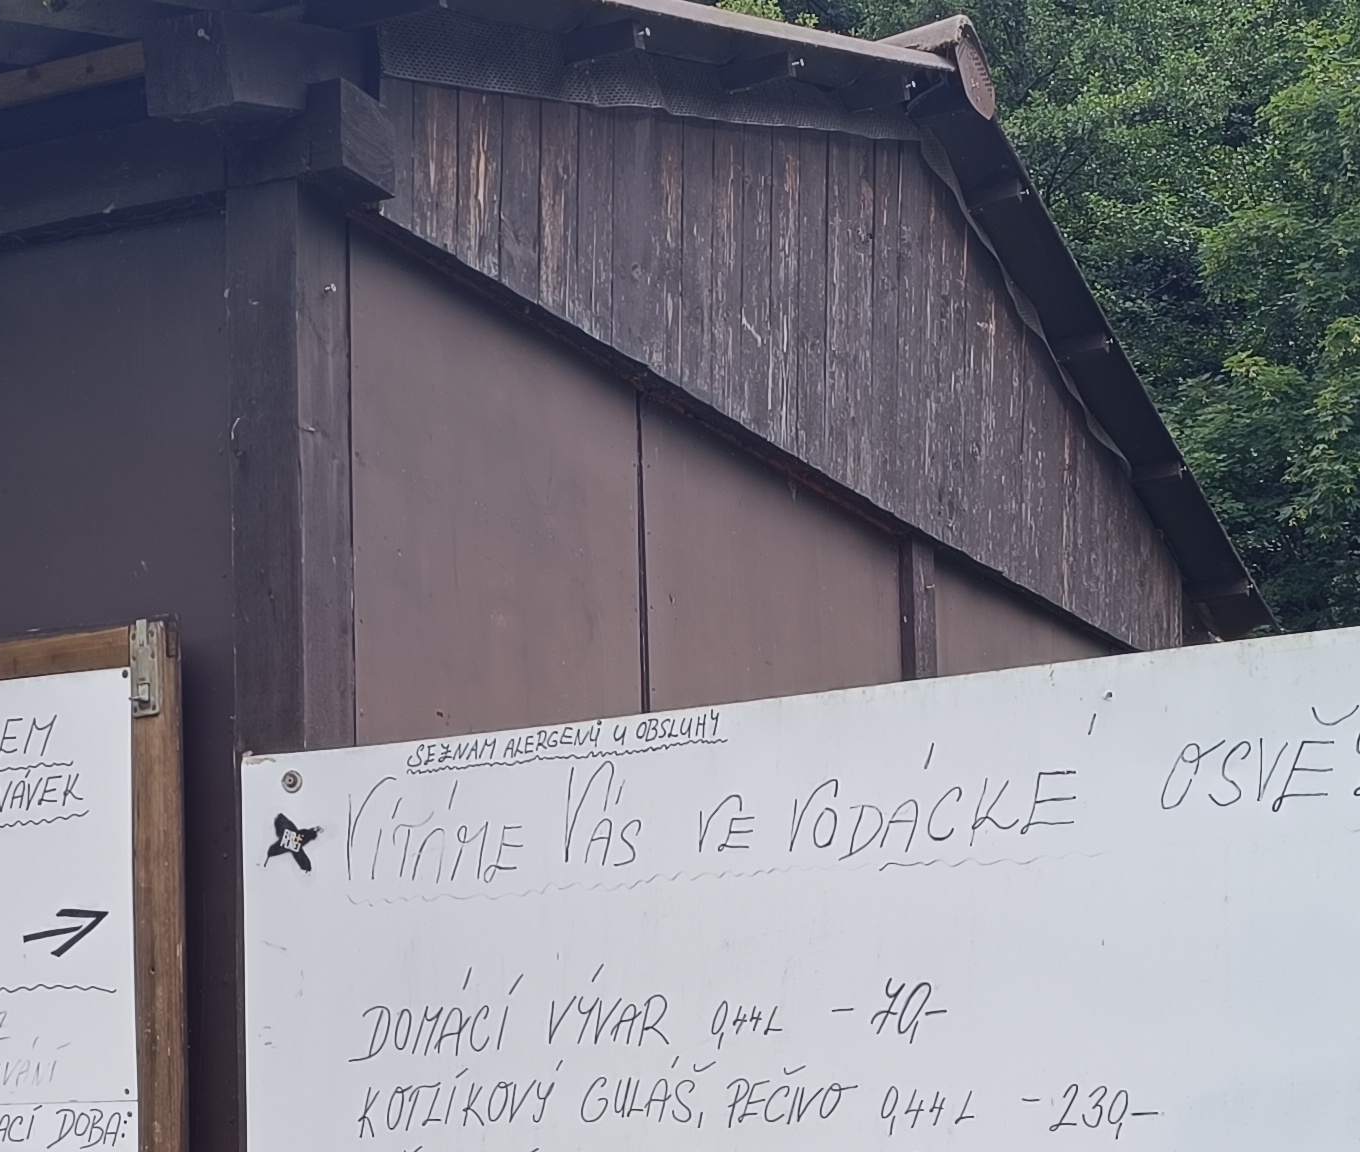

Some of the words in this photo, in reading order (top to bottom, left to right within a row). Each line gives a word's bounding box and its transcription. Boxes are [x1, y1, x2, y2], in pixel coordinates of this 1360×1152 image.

[407, 740, 497, 768] SEZNAM
[613, 725, 627, 746] U
[635, 708, 720, 742] OBSLUHY
[346, 775, 525, 884] VÍTÁME
[565, 761, 642, 866] VÁS
[697, 794, 756, 853] VE
[789, 712, 1097, 861] VODÁCKÉ
[347, 966, 524, 1063] DOMÁCÍ
[548, 963, 670, 1047] VÝVAR
[357, 1059, 564, 1139] KOTLÍKOVÝ
[727, 1065, 859, 1129] PEČIVO
